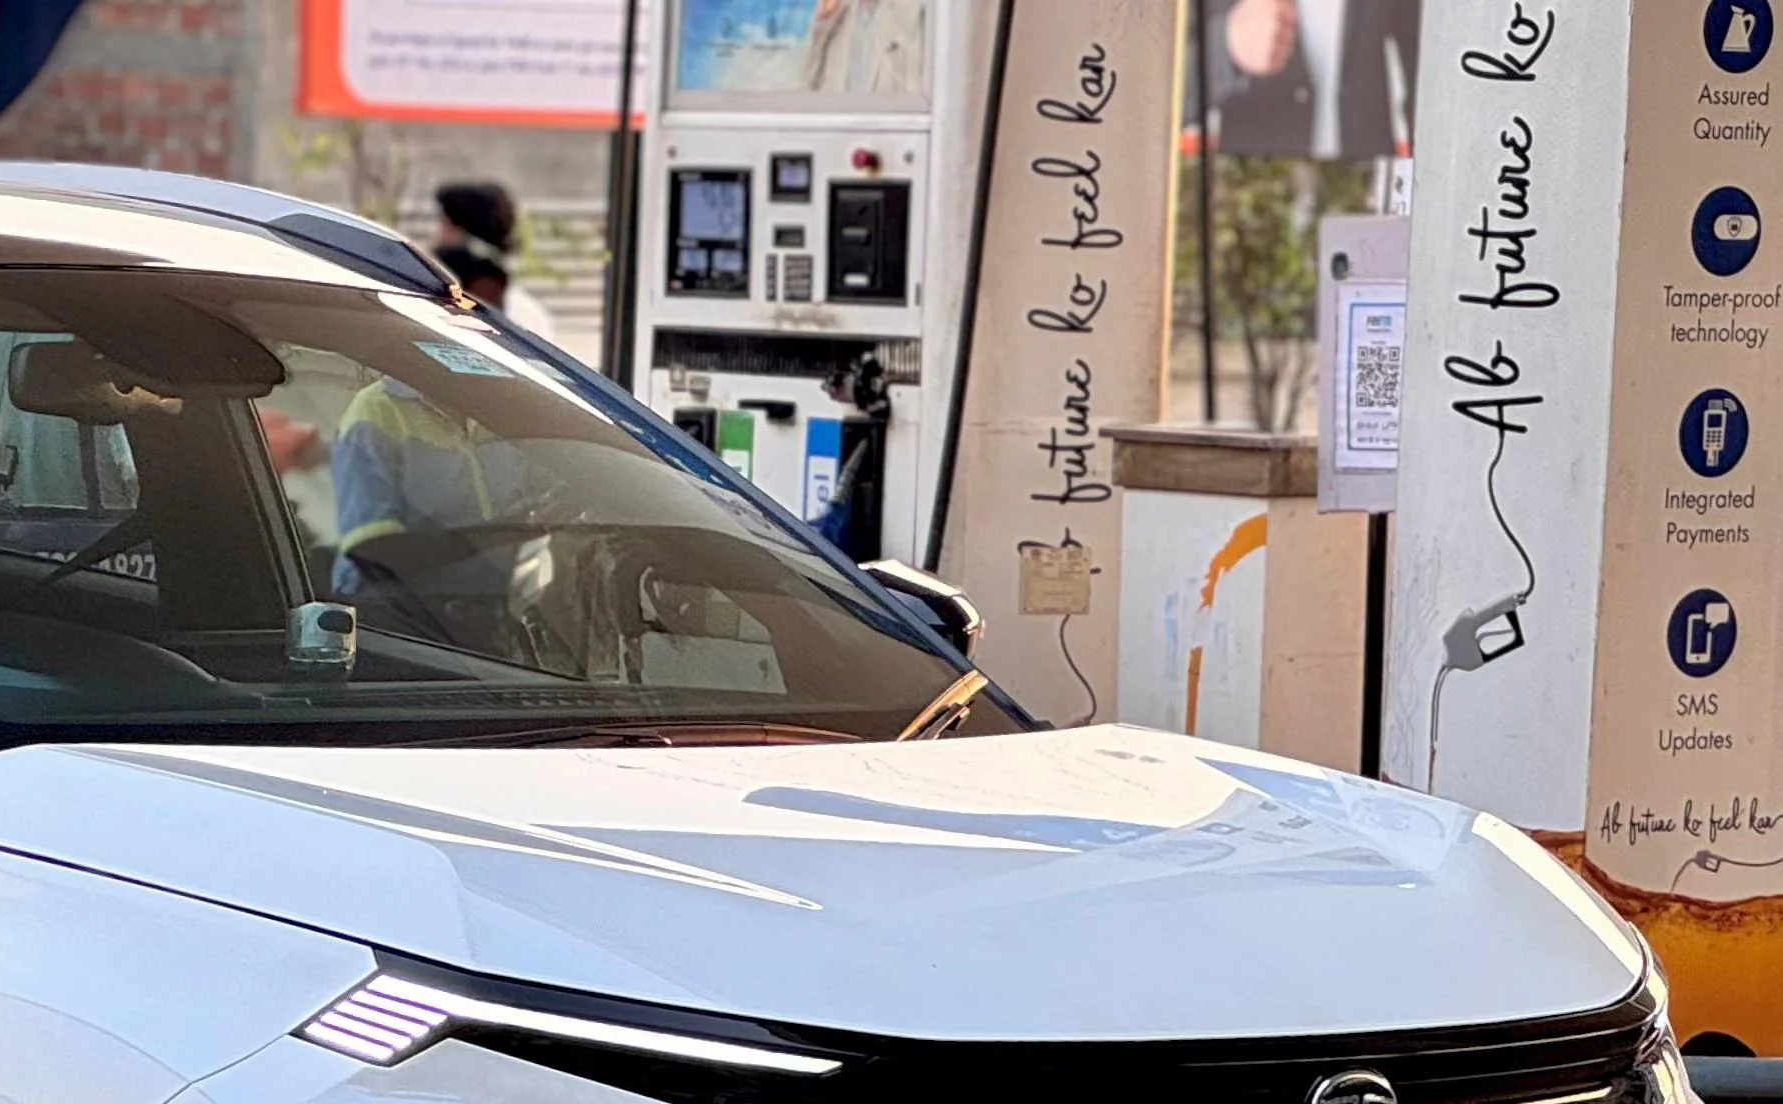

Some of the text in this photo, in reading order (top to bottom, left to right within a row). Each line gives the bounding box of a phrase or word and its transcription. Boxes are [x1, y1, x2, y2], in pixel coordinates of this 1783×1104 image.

[1697, 83, 1770, 106] Assured
[1693, 117, 1771, 148] Quantity
[1031, 150, 1123, 250] feel
[1444, 2, 1560, 434] Ab future ko
[1027, 273, 1107, 333] ko
[1663, 284, 1782, 314] Tamper-proof
[1670, 319, 1769, 349] technology
[1030, 358, 1112, 505] future
[1665, 486, 1755, 515] Integrated
[1666, 522, 1749, 549] Payments
[1676, 693, 1719, 716] SMS
[1658, 727, 1733, 756] Updates
[1601, 801, 1623, 844] Ab
[1629, 806, 1676, 846] future
[1683, 799, 1703, 837] ko
[1710, 796, 1741, 843] feel
